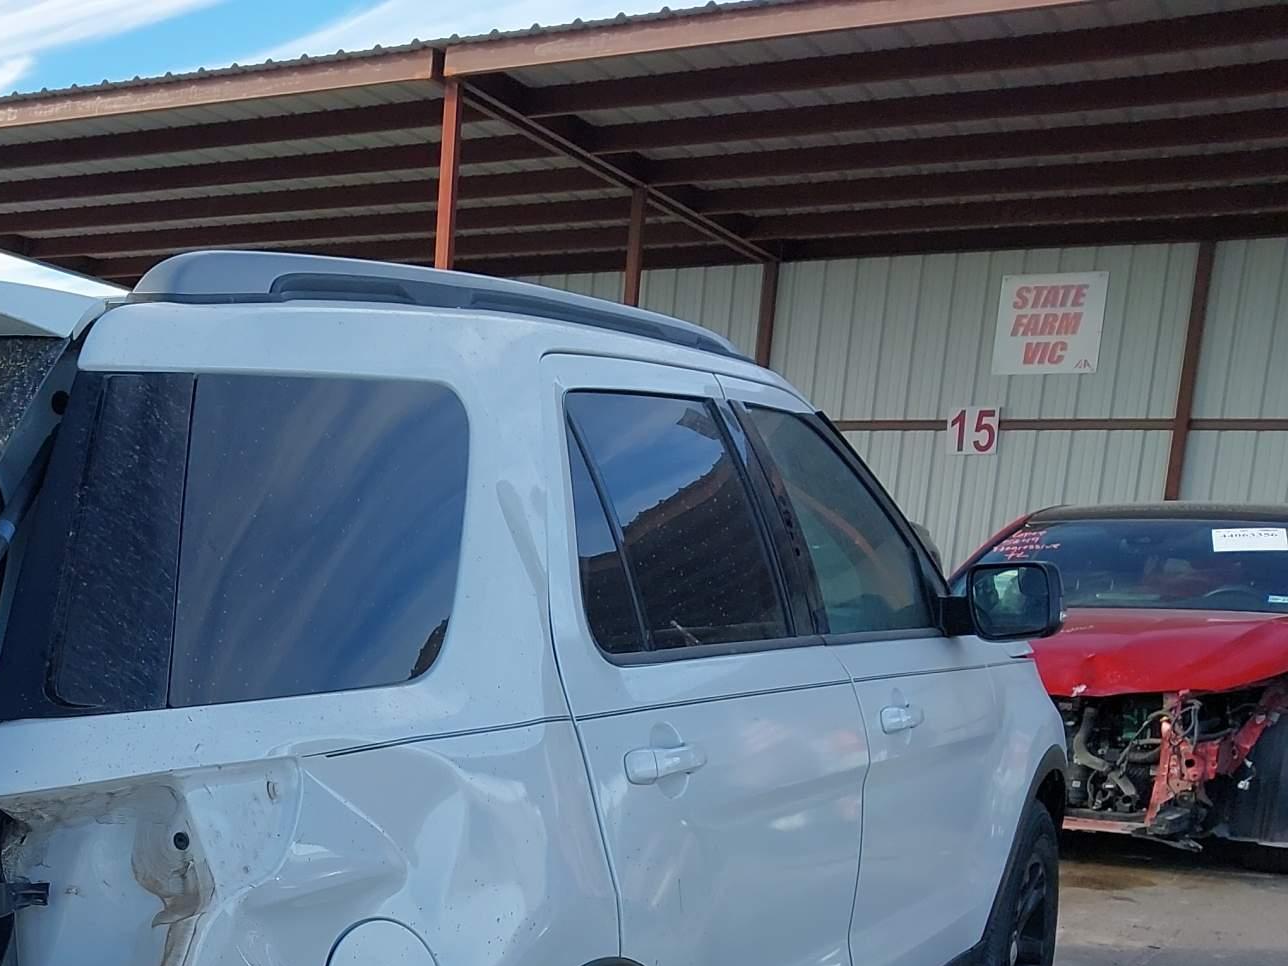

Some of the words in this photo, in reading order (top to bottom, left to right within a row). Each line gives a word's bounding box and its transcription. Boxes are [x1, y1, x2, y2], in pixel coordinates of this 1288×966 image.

[1013, 284, 1090, 310] STATE
[1010, 311, 1084, 336] FARM
[1022, 341, 1068, 365] VIC
[951, 409, 996, 452] 15
